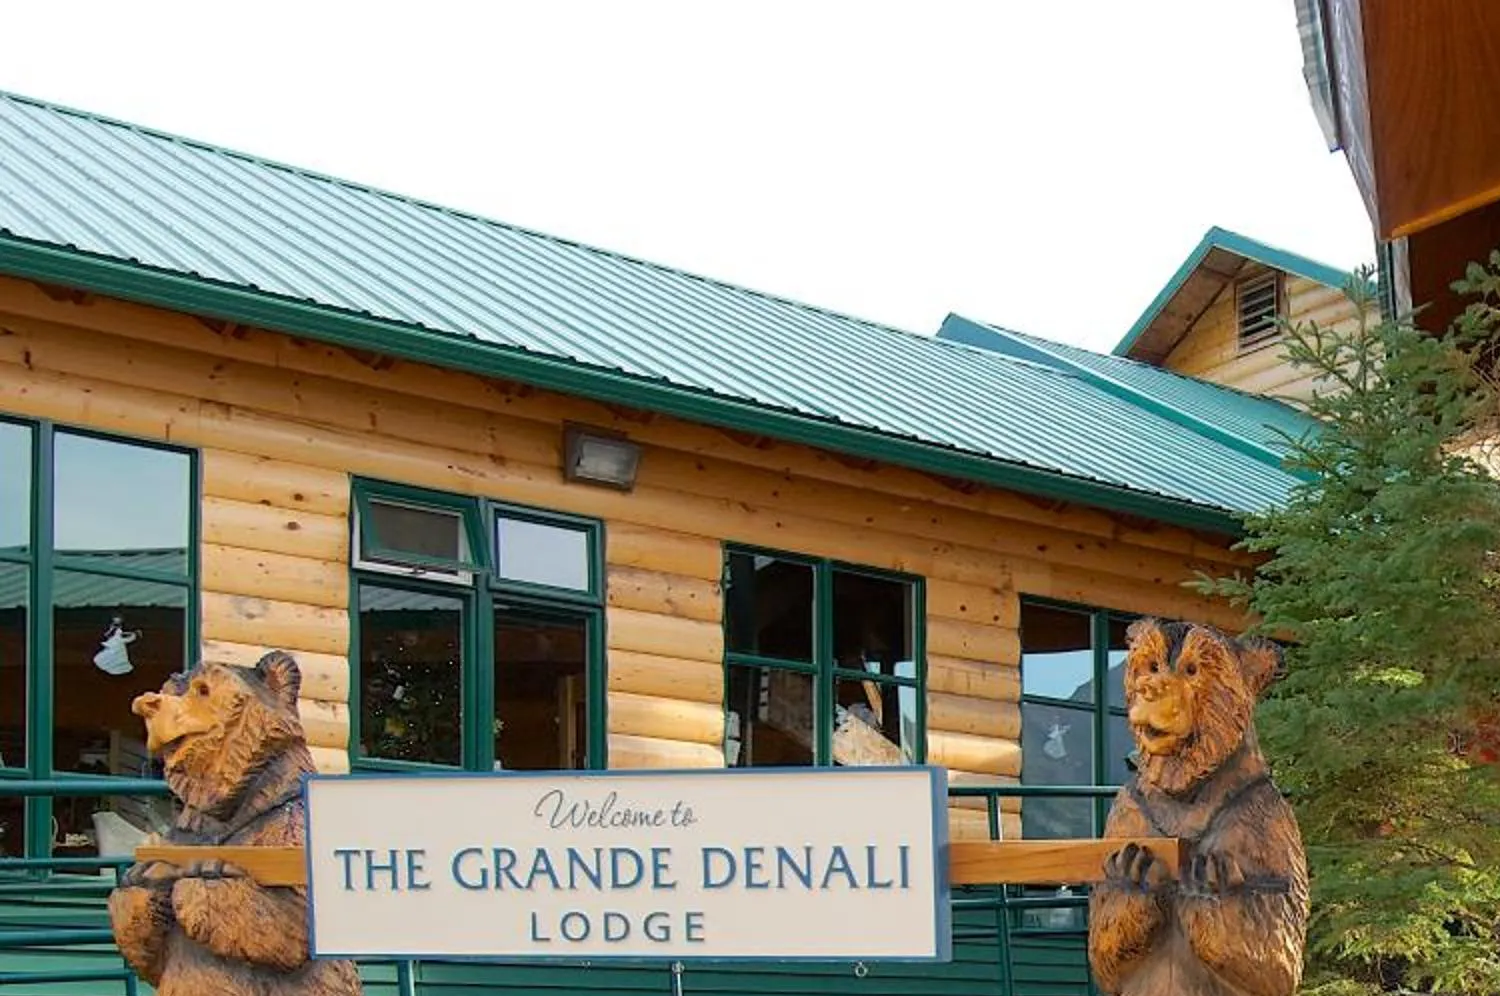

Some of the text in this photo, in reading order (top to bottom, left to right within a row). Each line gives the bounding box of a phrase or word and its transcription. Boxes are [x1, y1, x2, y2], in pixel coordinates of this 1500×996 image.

[533, 789, 698, 829] Welcome to
[333, 845, 910, 893] THE GRANDE DENALI
[531, 911, 705, 944] LODGE
